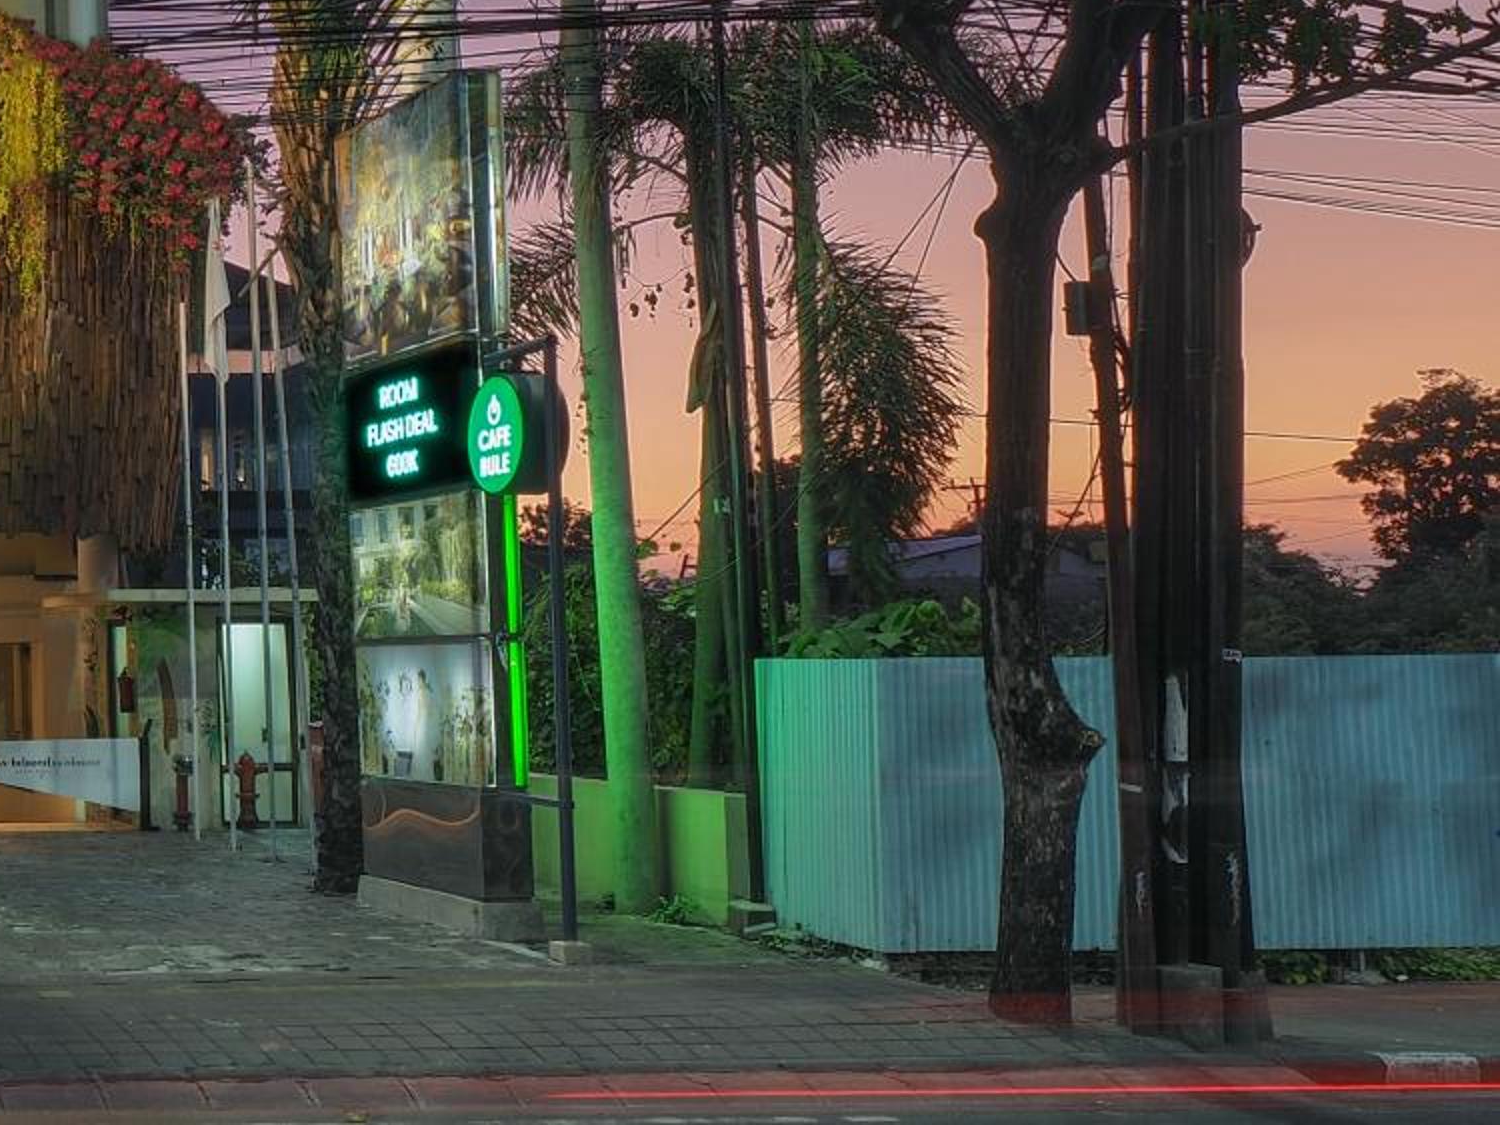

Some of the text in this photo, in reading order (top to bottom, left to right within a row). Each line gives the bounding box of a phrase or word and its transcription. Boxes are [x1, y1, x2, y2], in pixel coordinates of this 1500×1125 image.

[378, 377, 419, 409] ROOM
[367, 408, 438, 447] FLASH DEAL
[478, 424, 511, 452] CAFE
[479, 452, 511, 477] BULE
